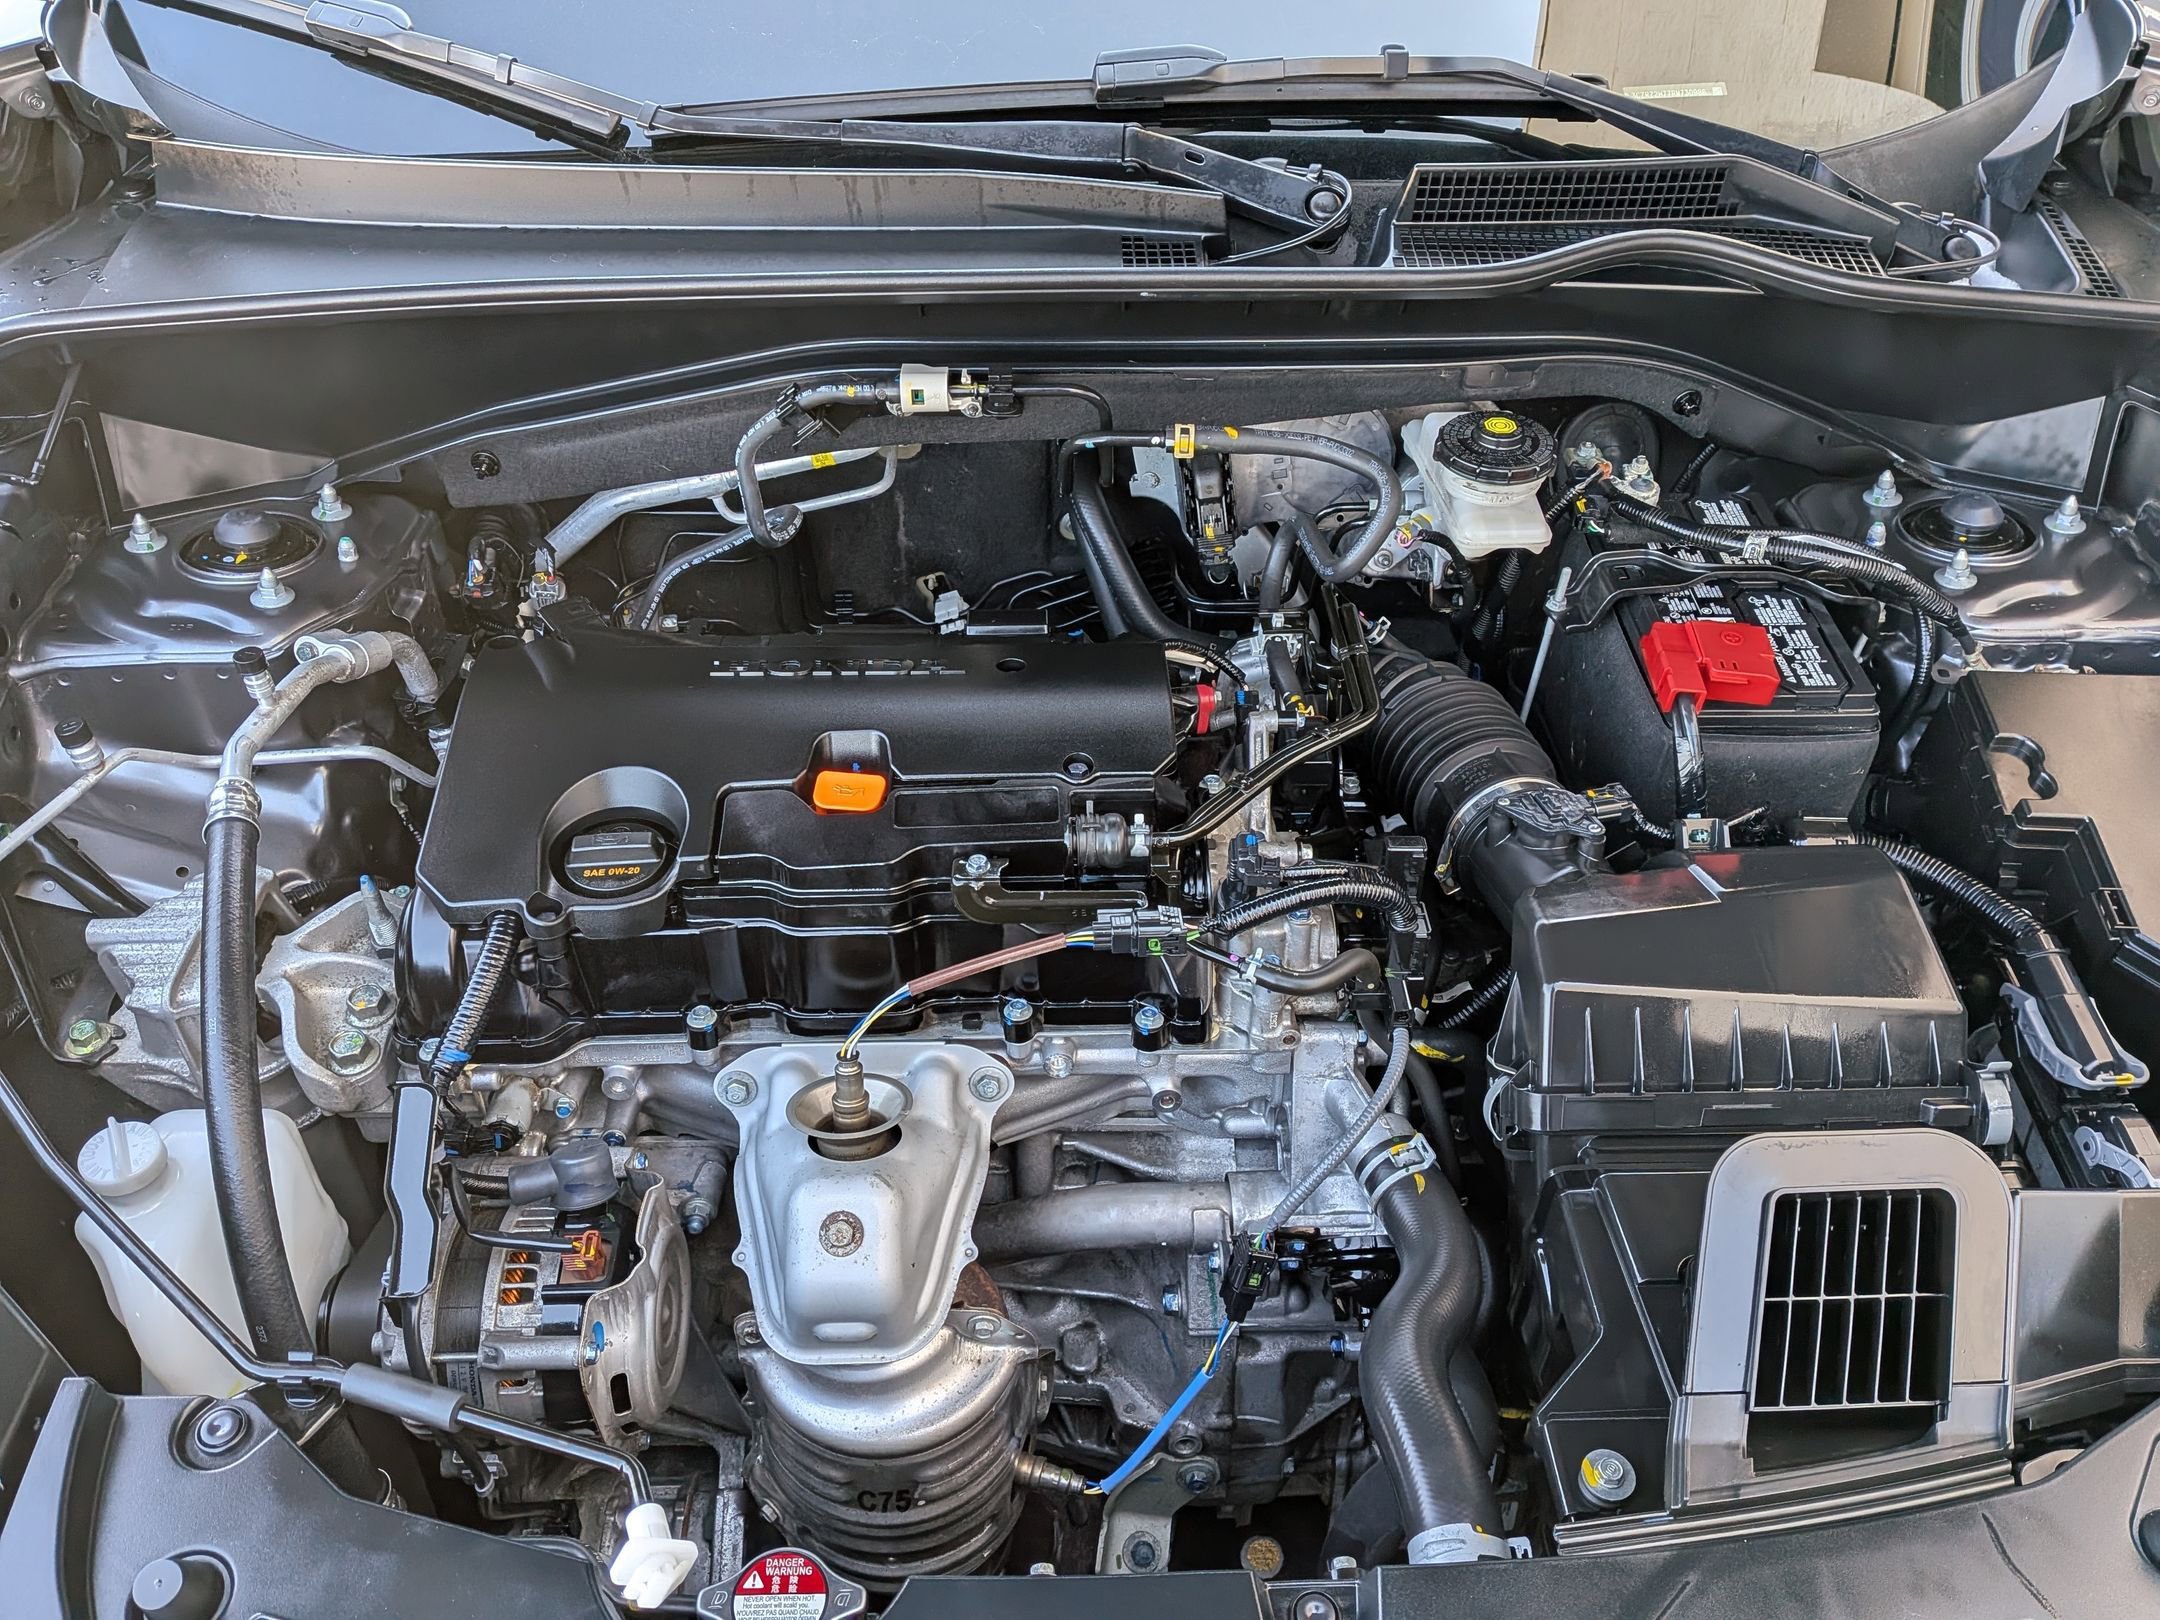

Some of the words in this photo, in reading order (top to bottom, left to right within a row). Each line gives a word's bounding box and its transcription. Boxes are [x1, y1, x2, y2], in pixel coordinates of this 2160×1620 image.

[583, 868, 606, 877] SAE
[608, 866, 640, 876] 0W-20
[857, 1488, 912, 1513] C75
[766, 1558, 805, 1567] DANGER
[765, 1566, 813, 1576] WARNUNG
